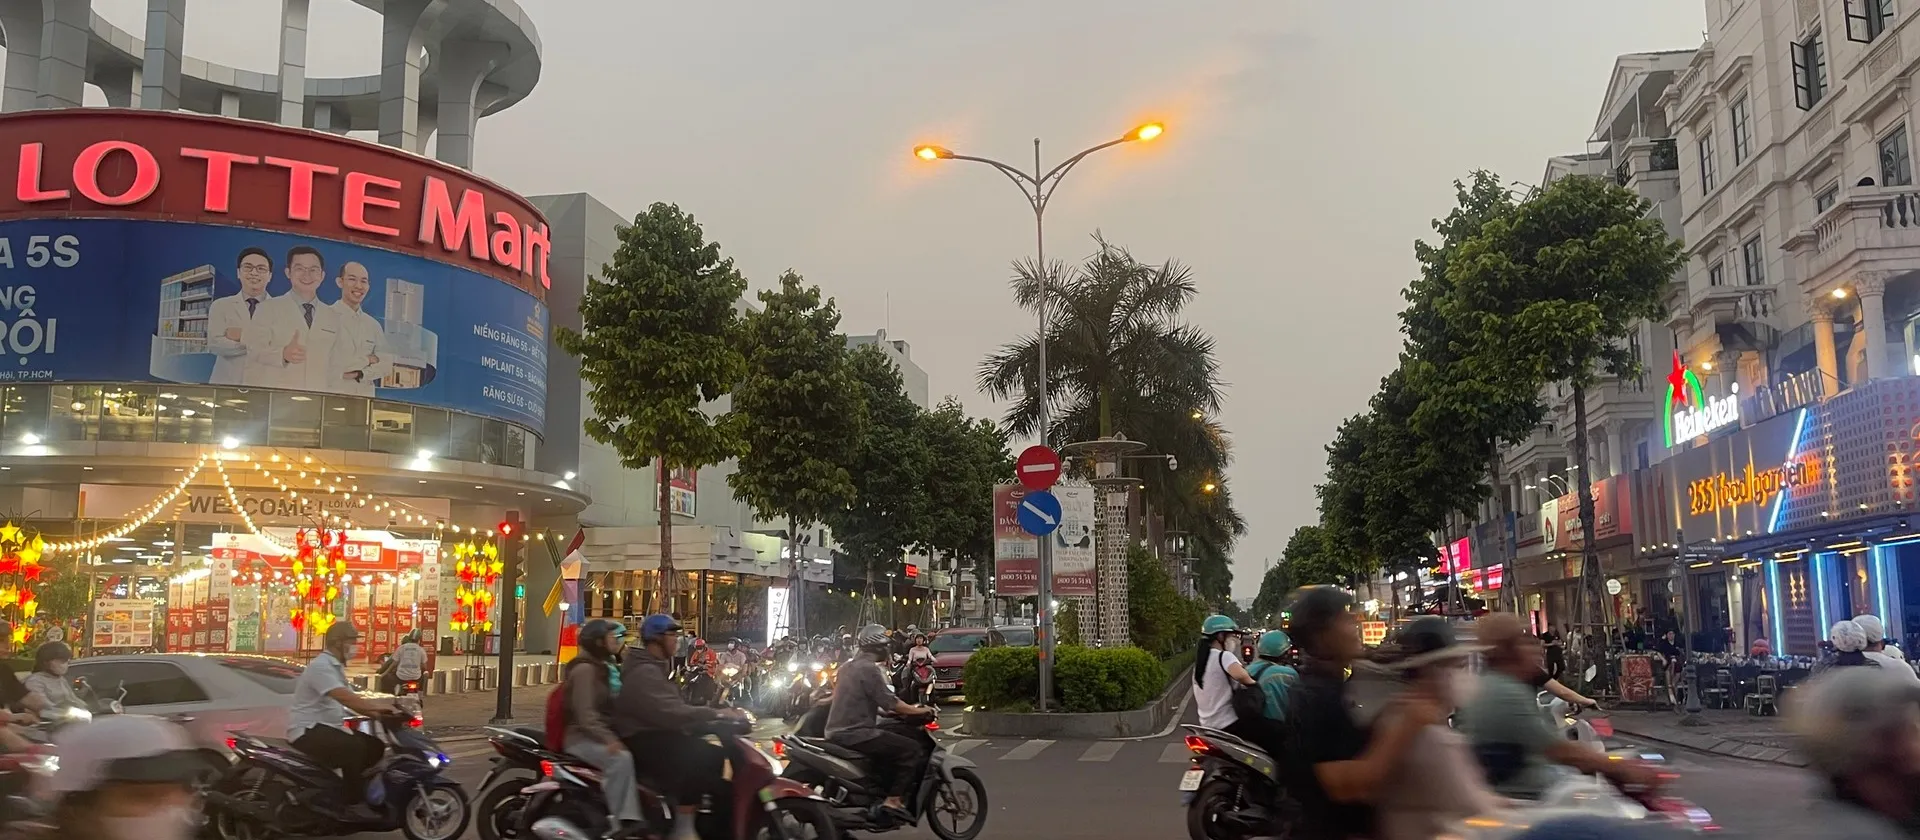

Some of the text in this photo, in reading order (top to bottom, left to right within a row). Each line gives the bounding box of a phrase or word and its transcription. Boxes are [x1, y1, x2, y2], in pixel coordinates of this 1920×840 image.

[17, 140, 552, 289] LOTTE Mart
[26, 234, 80, 268] 5S
[0, 308, 57, 366] ỘI
[17, 370, 53, 379] TP.HCM
[481, 355, 515, 375] IMPLANT
[515, 367, 524, 379] 5S
[483, 385, 506, 402] RĂNG
[1674, 382, 1739, 444] Heineken
[1688, 459, 1809, 515] 255 food garden
